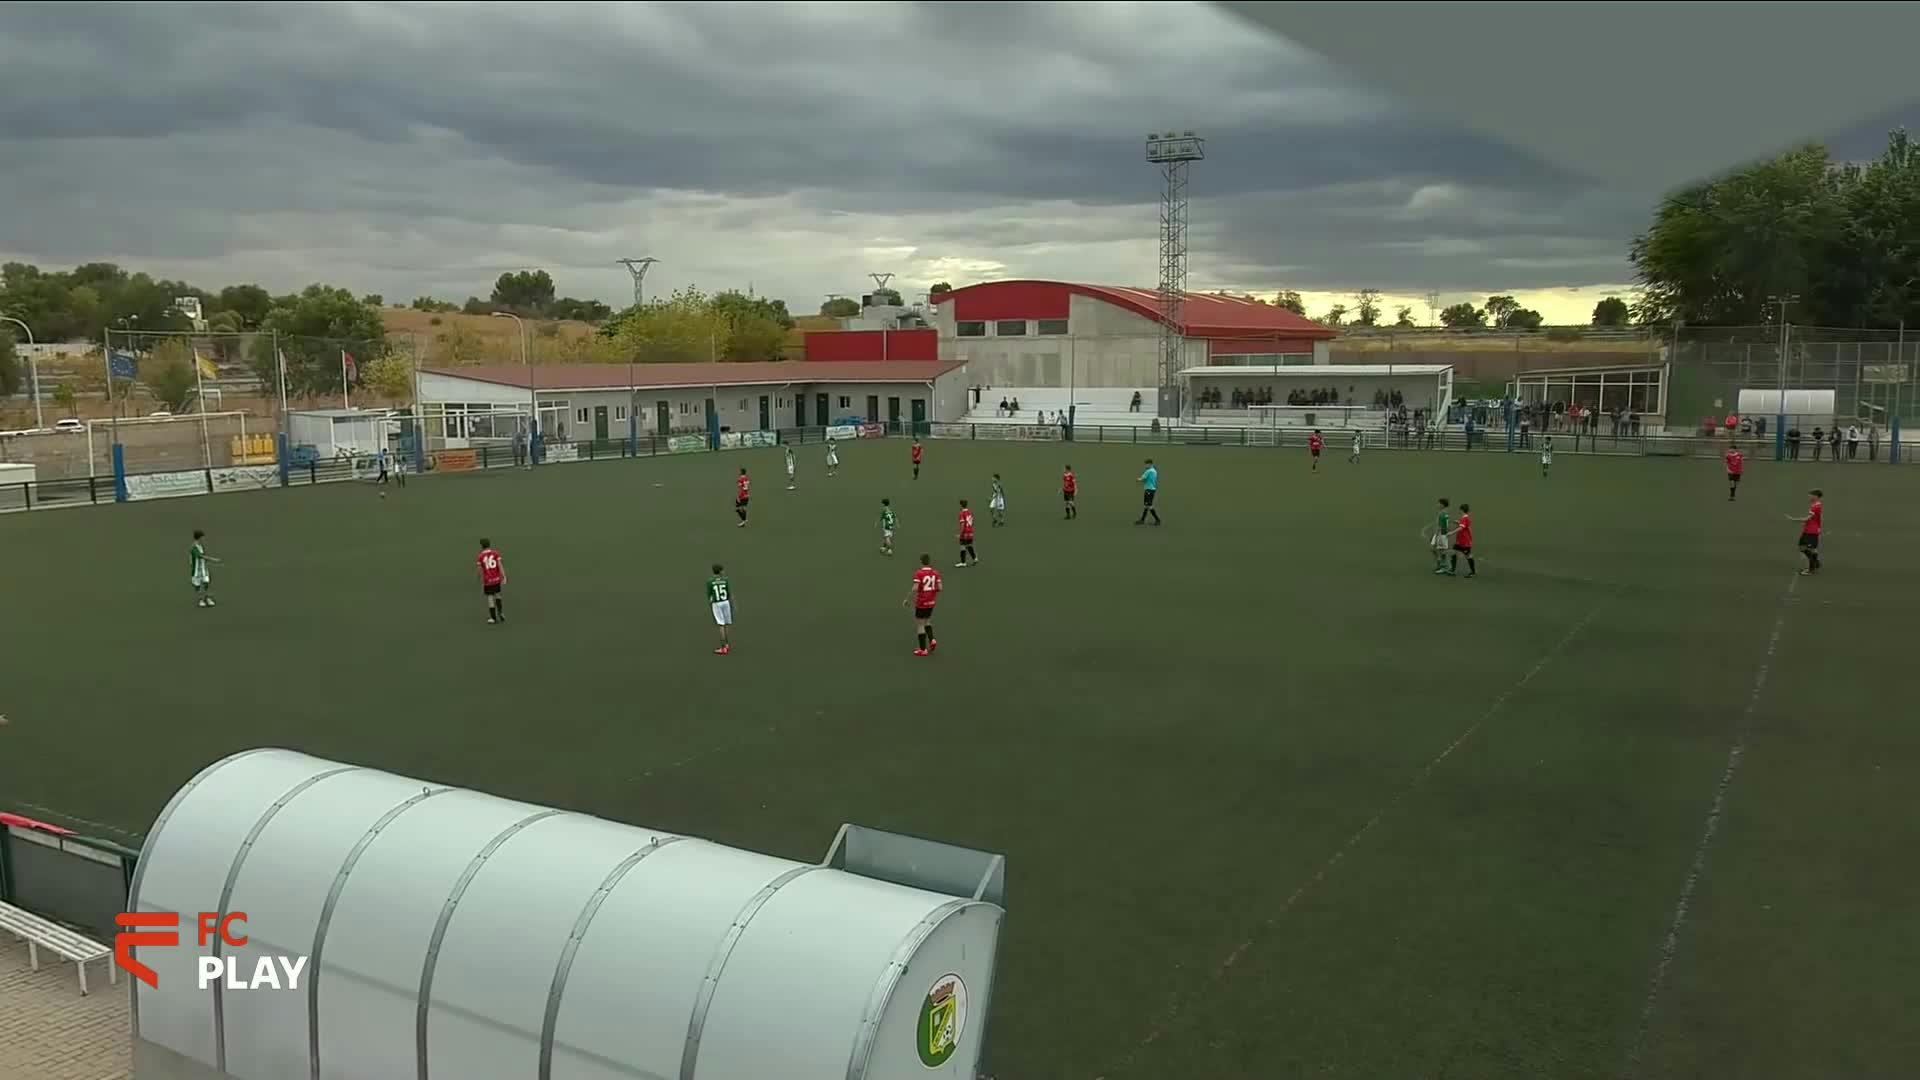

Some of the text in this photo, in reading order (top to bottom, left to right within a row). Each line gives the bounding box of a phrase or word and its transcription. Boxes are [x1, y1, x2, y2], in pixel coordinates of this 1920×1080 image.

[483, 555, 497, 570] 16
[922, 575, 936, 592] 21
[713, 584, 728, 601] 15
